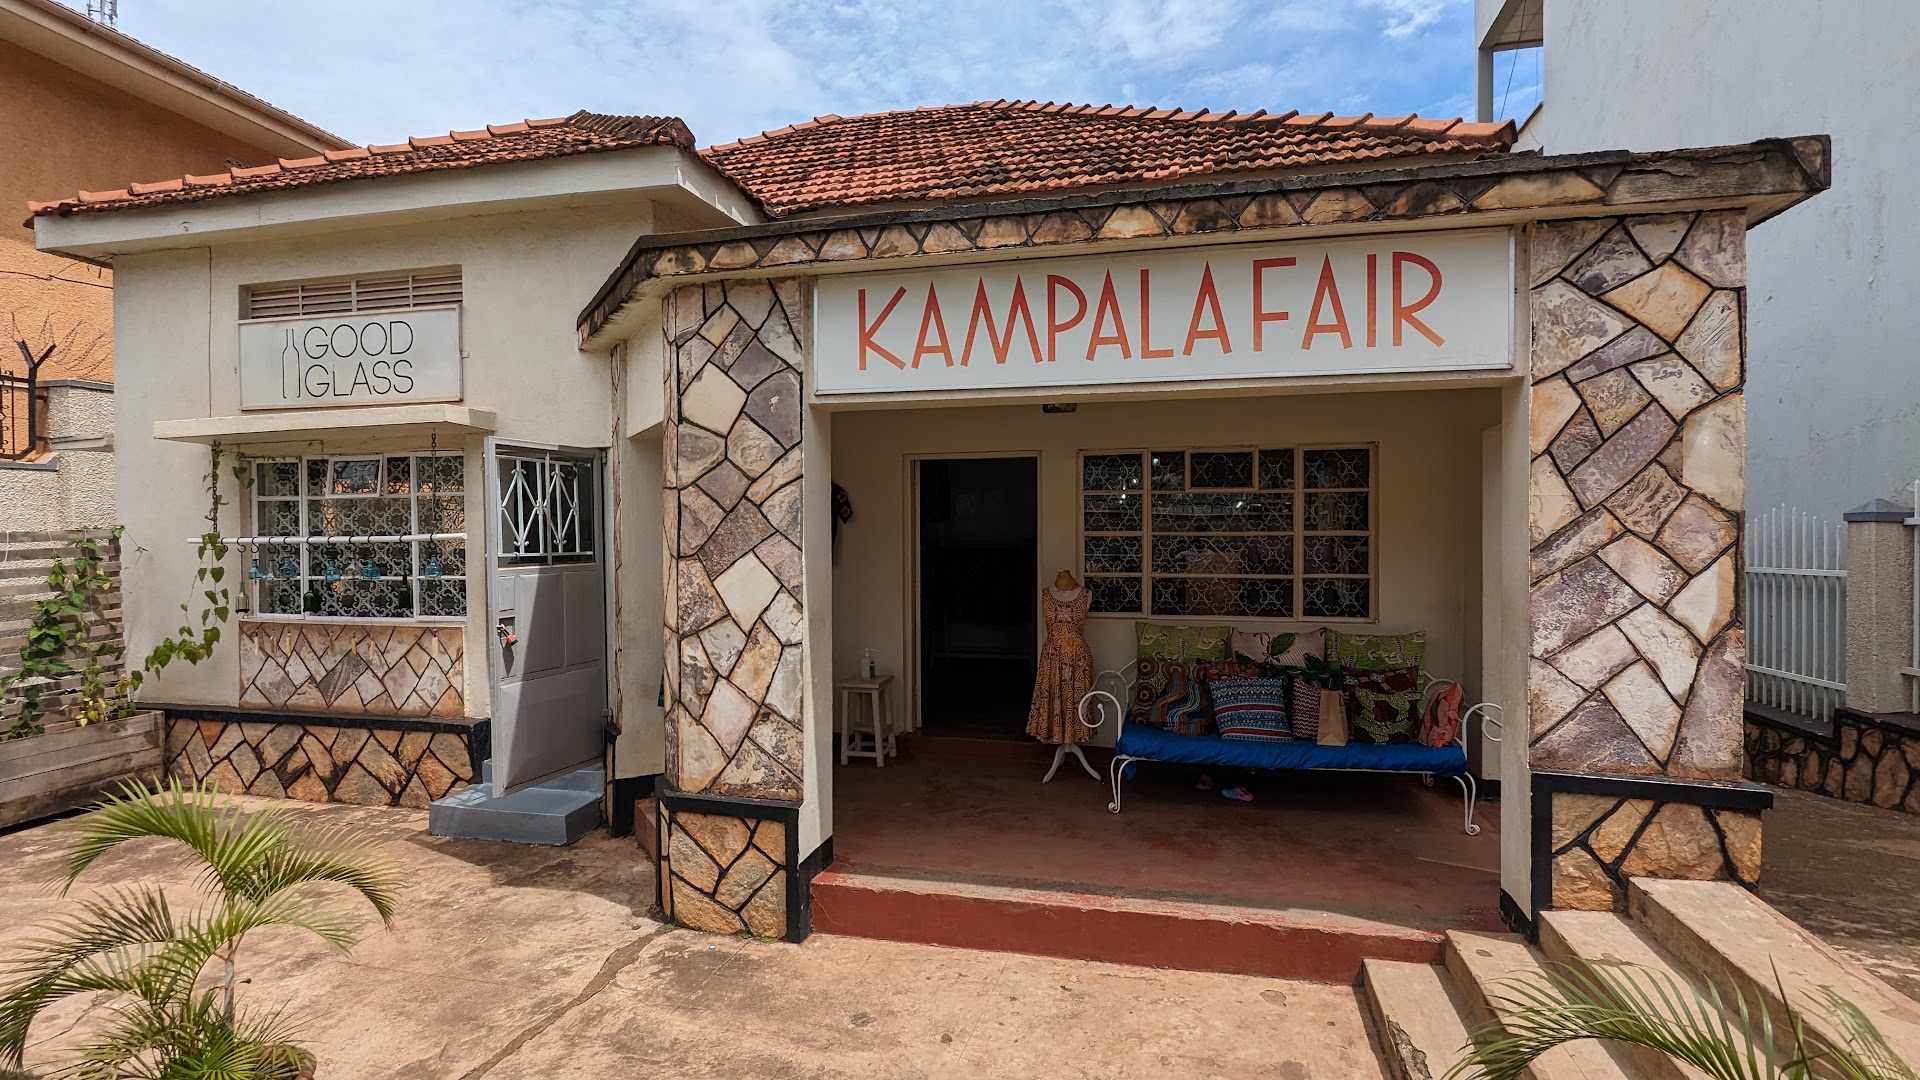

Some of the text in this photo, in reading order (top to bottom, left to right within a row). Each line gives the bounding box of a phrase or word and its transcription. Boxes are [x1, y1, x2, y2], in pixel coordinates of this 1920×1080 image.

[857, 251, 1445, 371] KAMPALA FAIR
[303, 320, 414, 360] GOOD
[304, 359, 414, 398] GLASS
